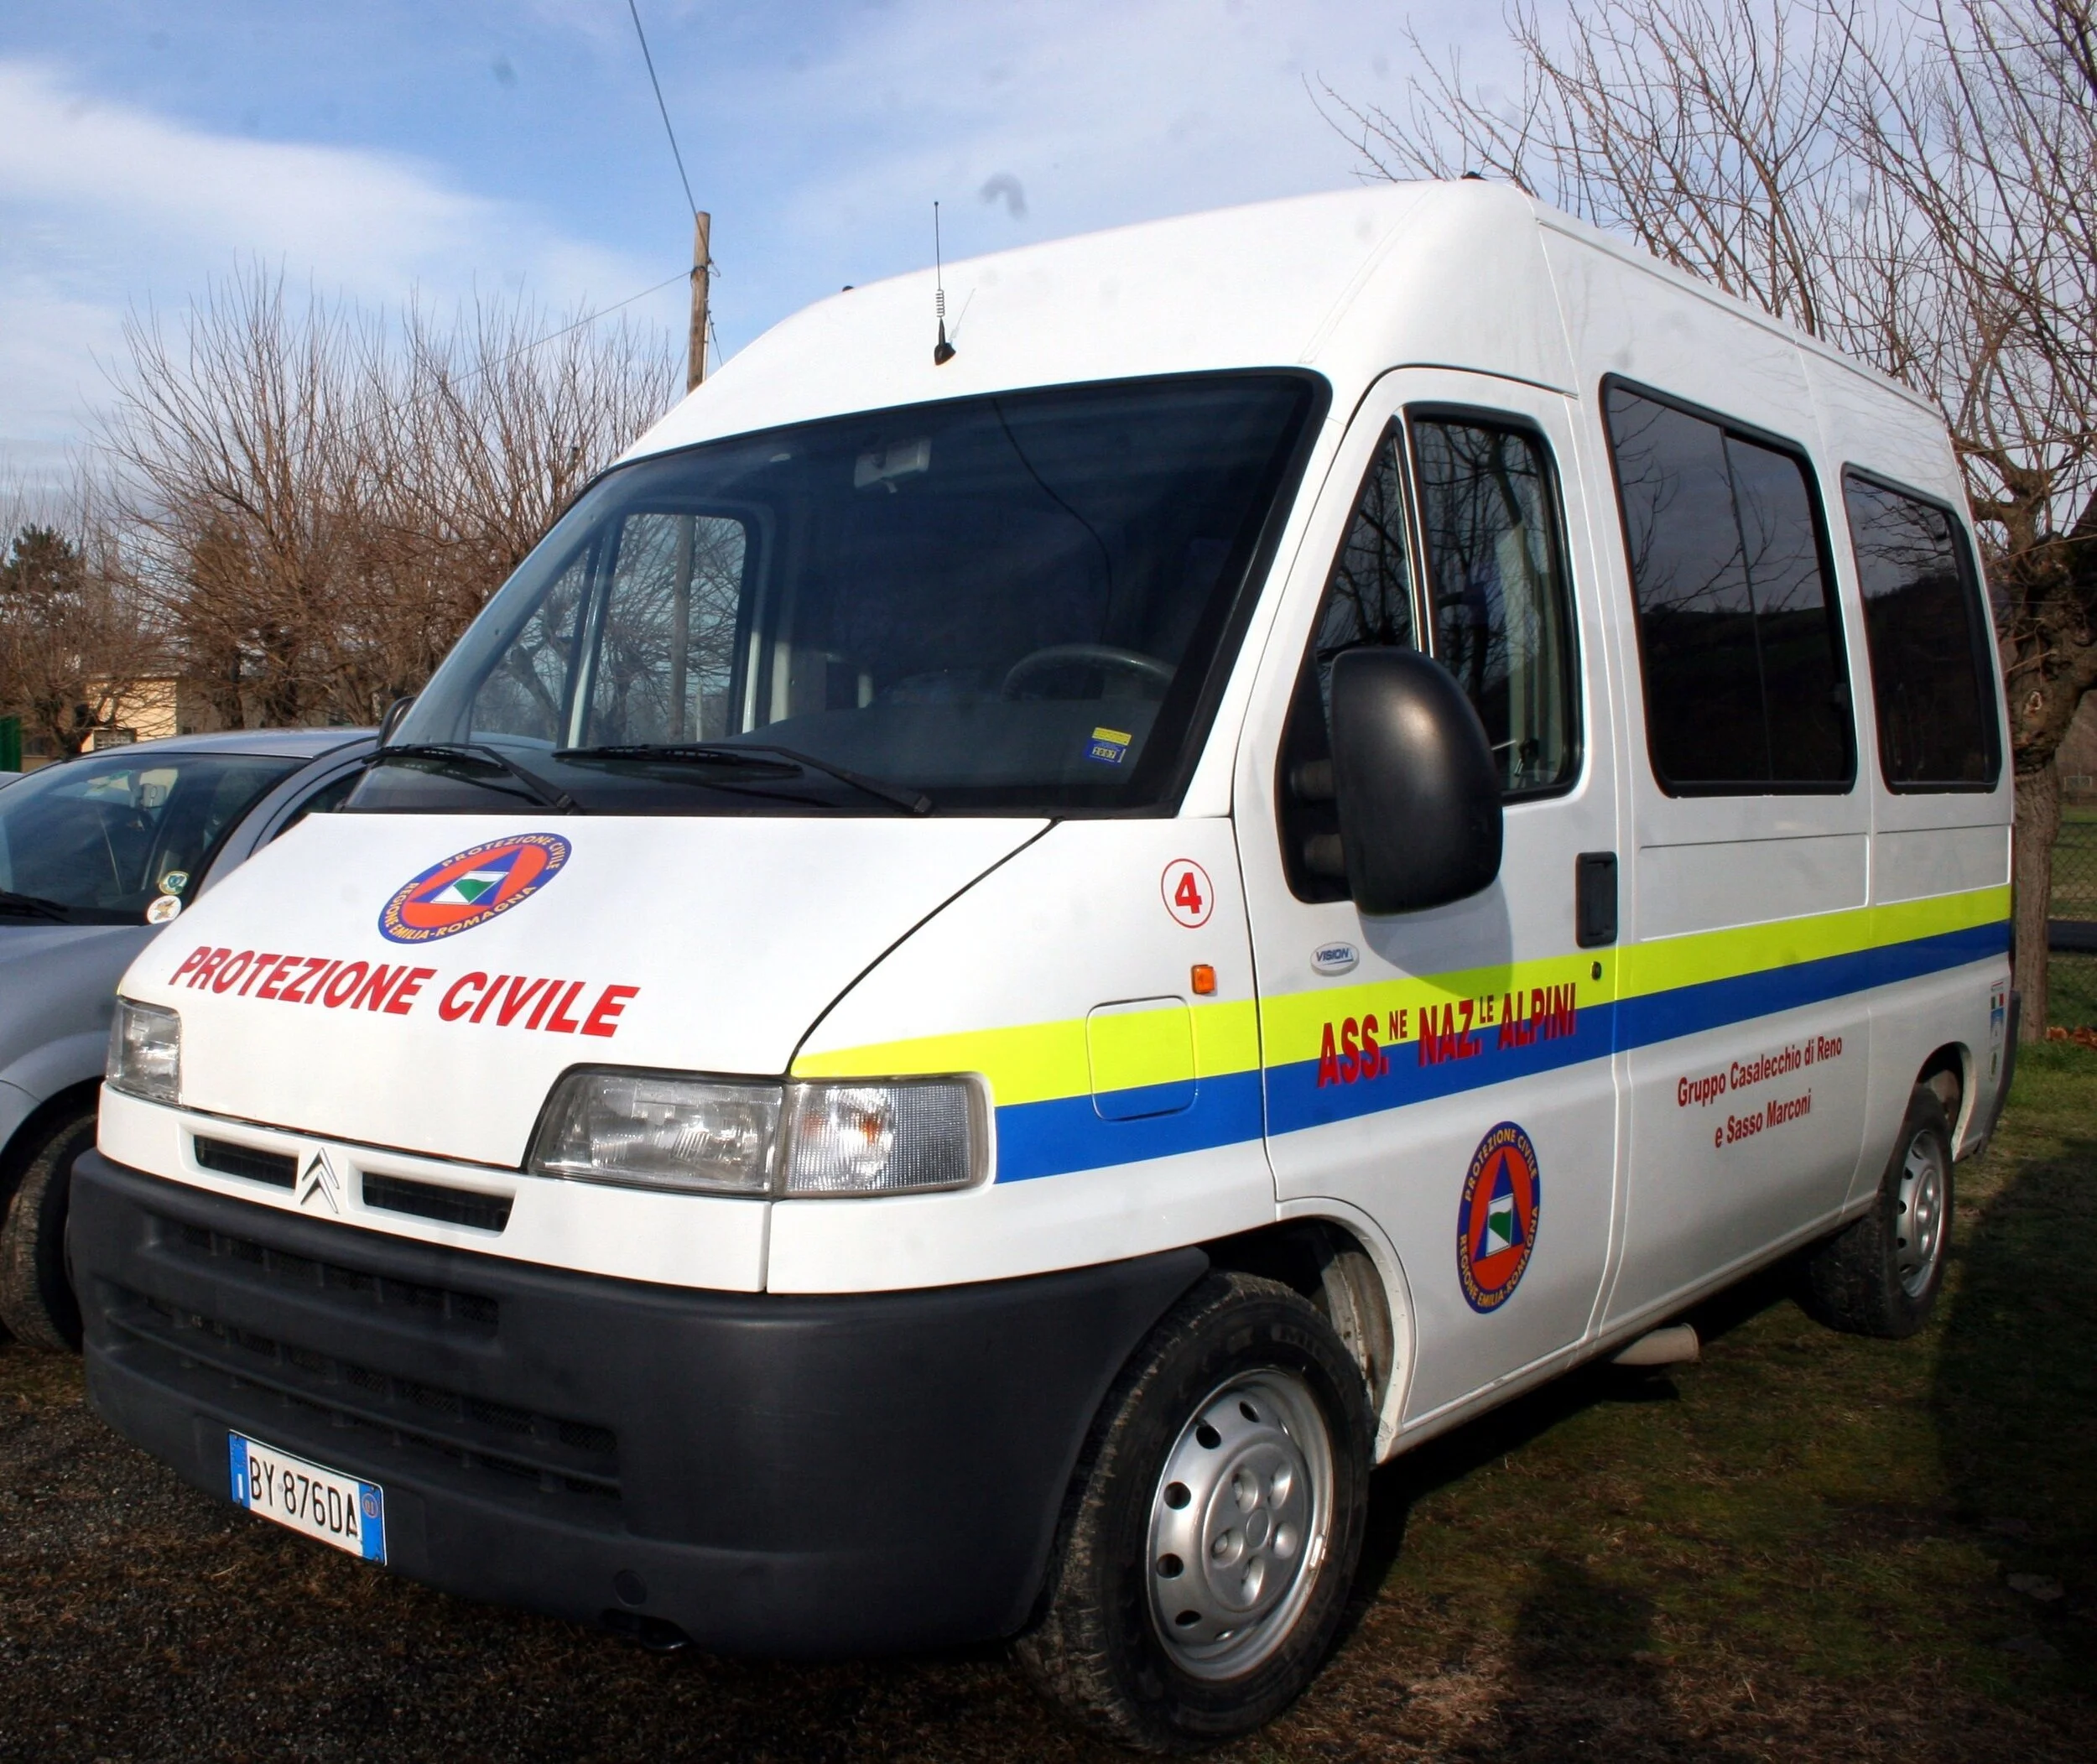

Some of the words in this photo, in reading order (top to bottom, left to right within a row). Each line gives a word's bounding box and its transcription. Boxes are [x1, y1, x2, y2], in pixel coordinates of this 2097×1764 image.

[441, 835, 555, 867] PROTEZIONE
[546, 842, 566, 871] CIVILE
[383, 882, 419, 928] REGIONE
[388, 885, 538, 940] EMILIA-ROMAGNA
[1174, 872, 1203, 914] 4
[1315, 947, 1350, 962] VISION
[168, 945, 438, 1016] PROTEZIONE
[438, 970, 641, 1038] CIVILE
[1497, 982, 1577, 1050] ALPINI
[1678, 1072, 1726, 1107] Gruppo
[1730, 1044, 1801, 1090] Casalecchio
[1804, 1039, 1814, 1066] di
[1817, 1035, 1843, 1062] Reno
[1715, 1127, 1723, 1148] e
[1726, 1111, 1762, 1143] Sasso
[1766, 1087, 1812, 1128] Marconi
[1465, 1127, 1517, 1202] PROTEZIONE
[1517, 1134, 1538, 1180] CIVILE
[1460, 1233, 1479, 1300] REGIONE
[1477, 1205, 1539, 1307] EMILIA-ROMAGNA
[249, 1455, 274, 1506] BY
[283, 1470, 359, 1538] 876DA
